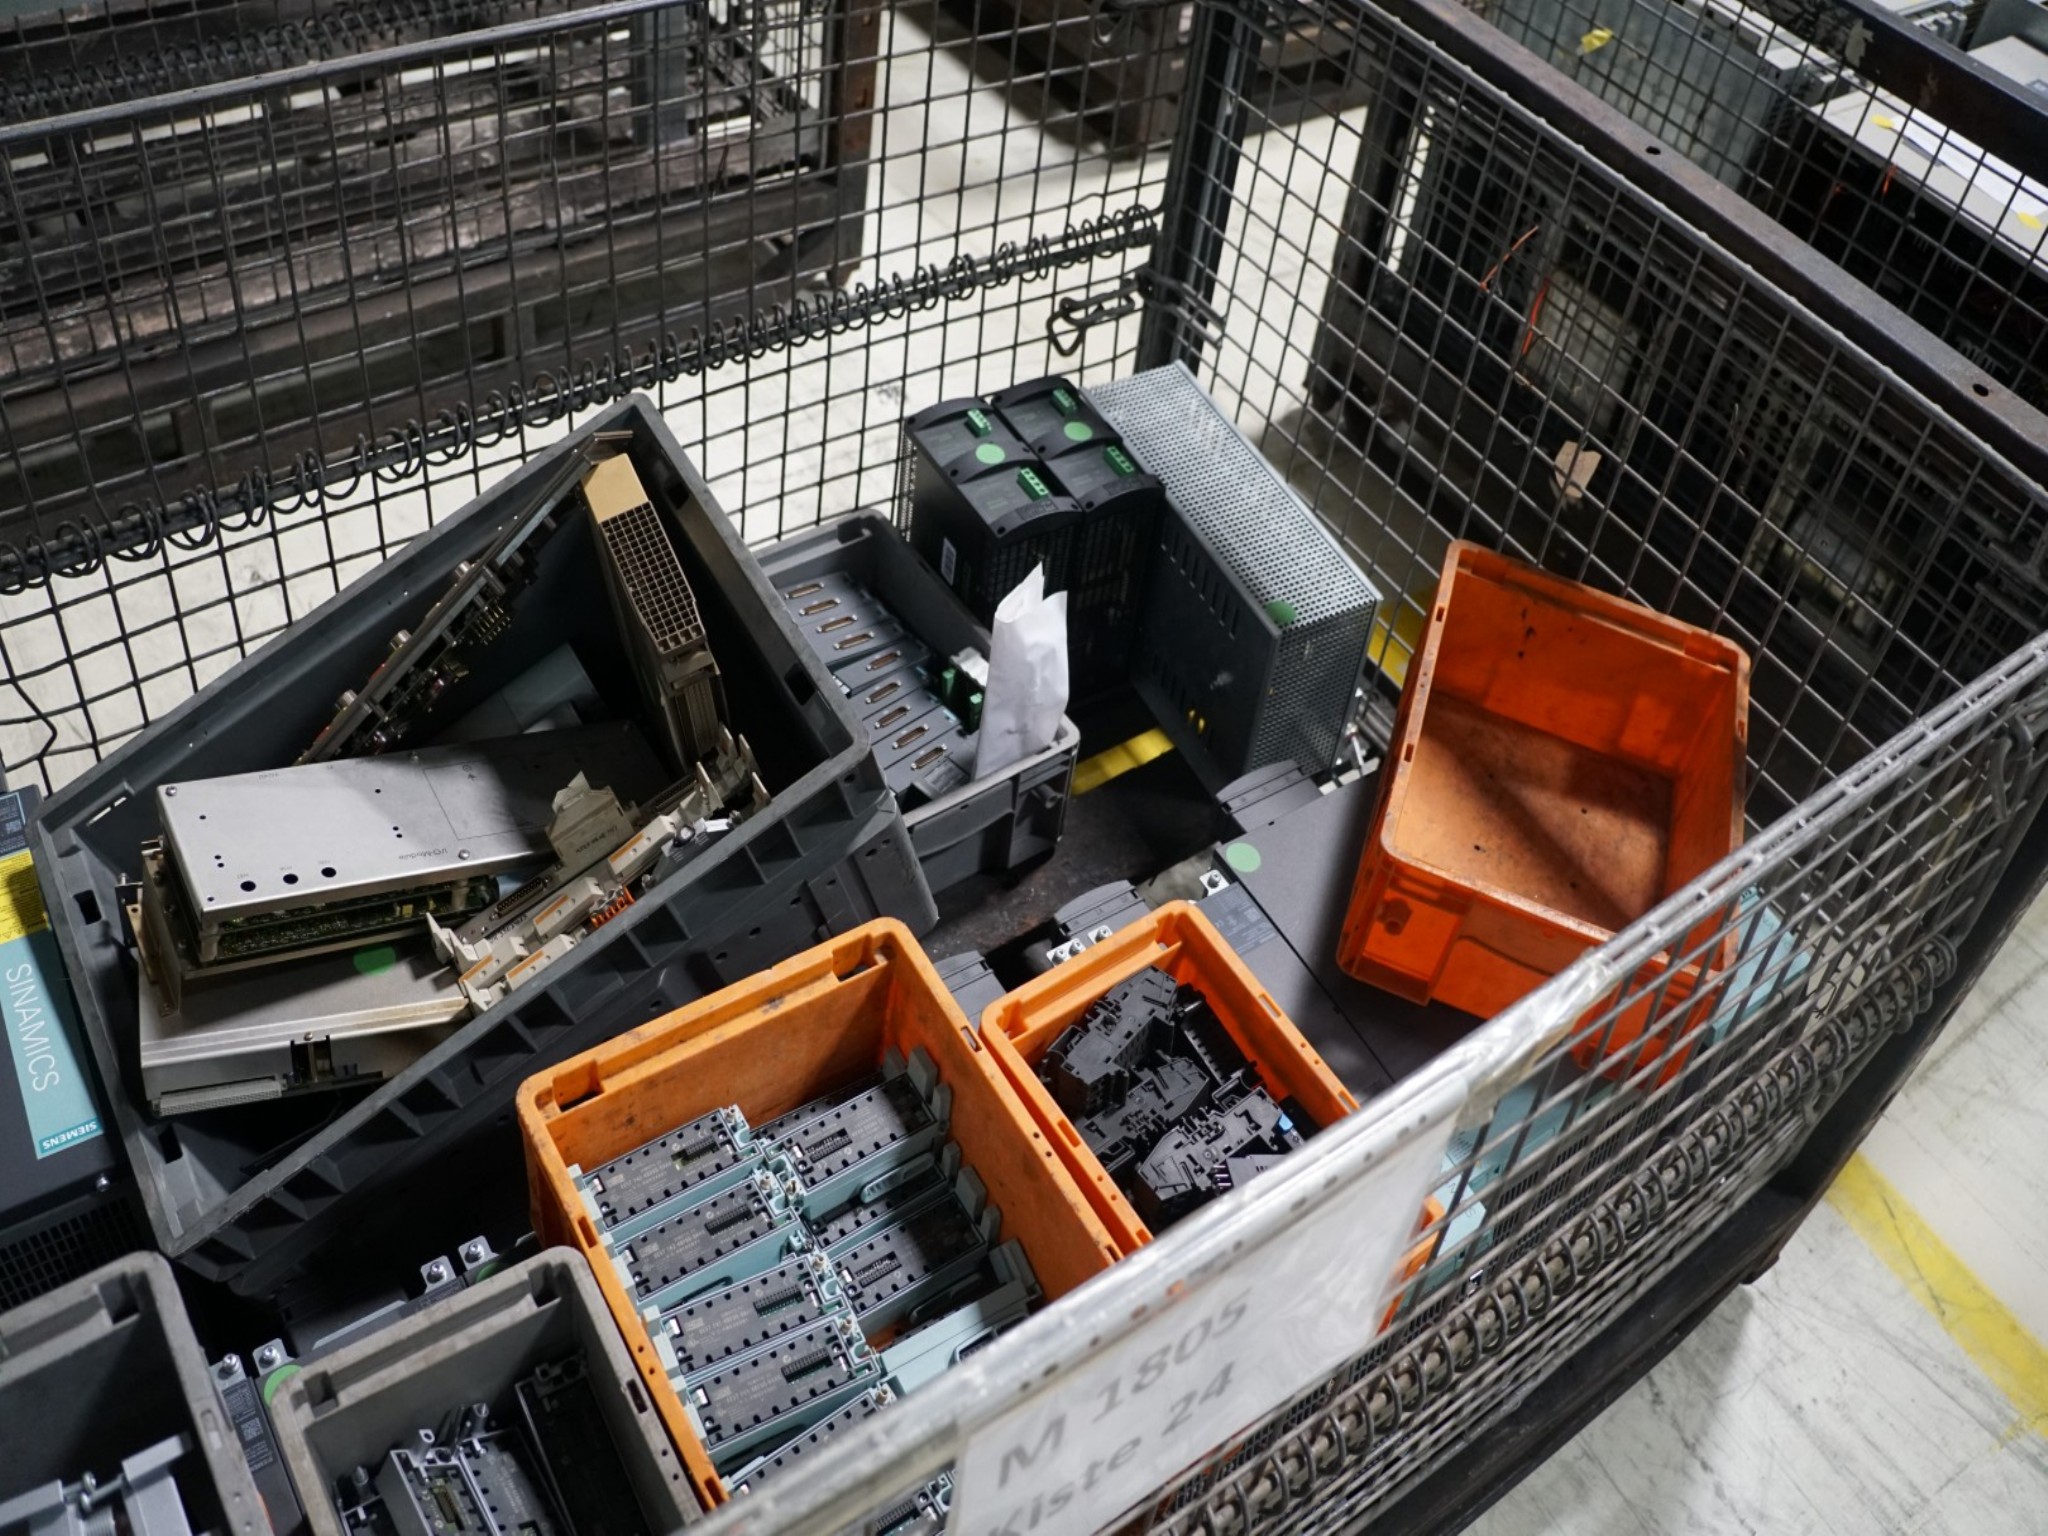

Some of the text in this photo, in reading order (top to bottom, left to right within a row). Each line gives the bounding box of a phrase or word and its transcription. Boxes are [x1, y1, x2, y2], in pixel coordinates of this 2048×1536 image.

[5, 963, 60, 1093] SINAMICS
[41, 1120, 98, 1151] SIEMENS
[998, 1287, 1252, 1490] M 1805
[1161, 1360, 1236, 1438] 24
